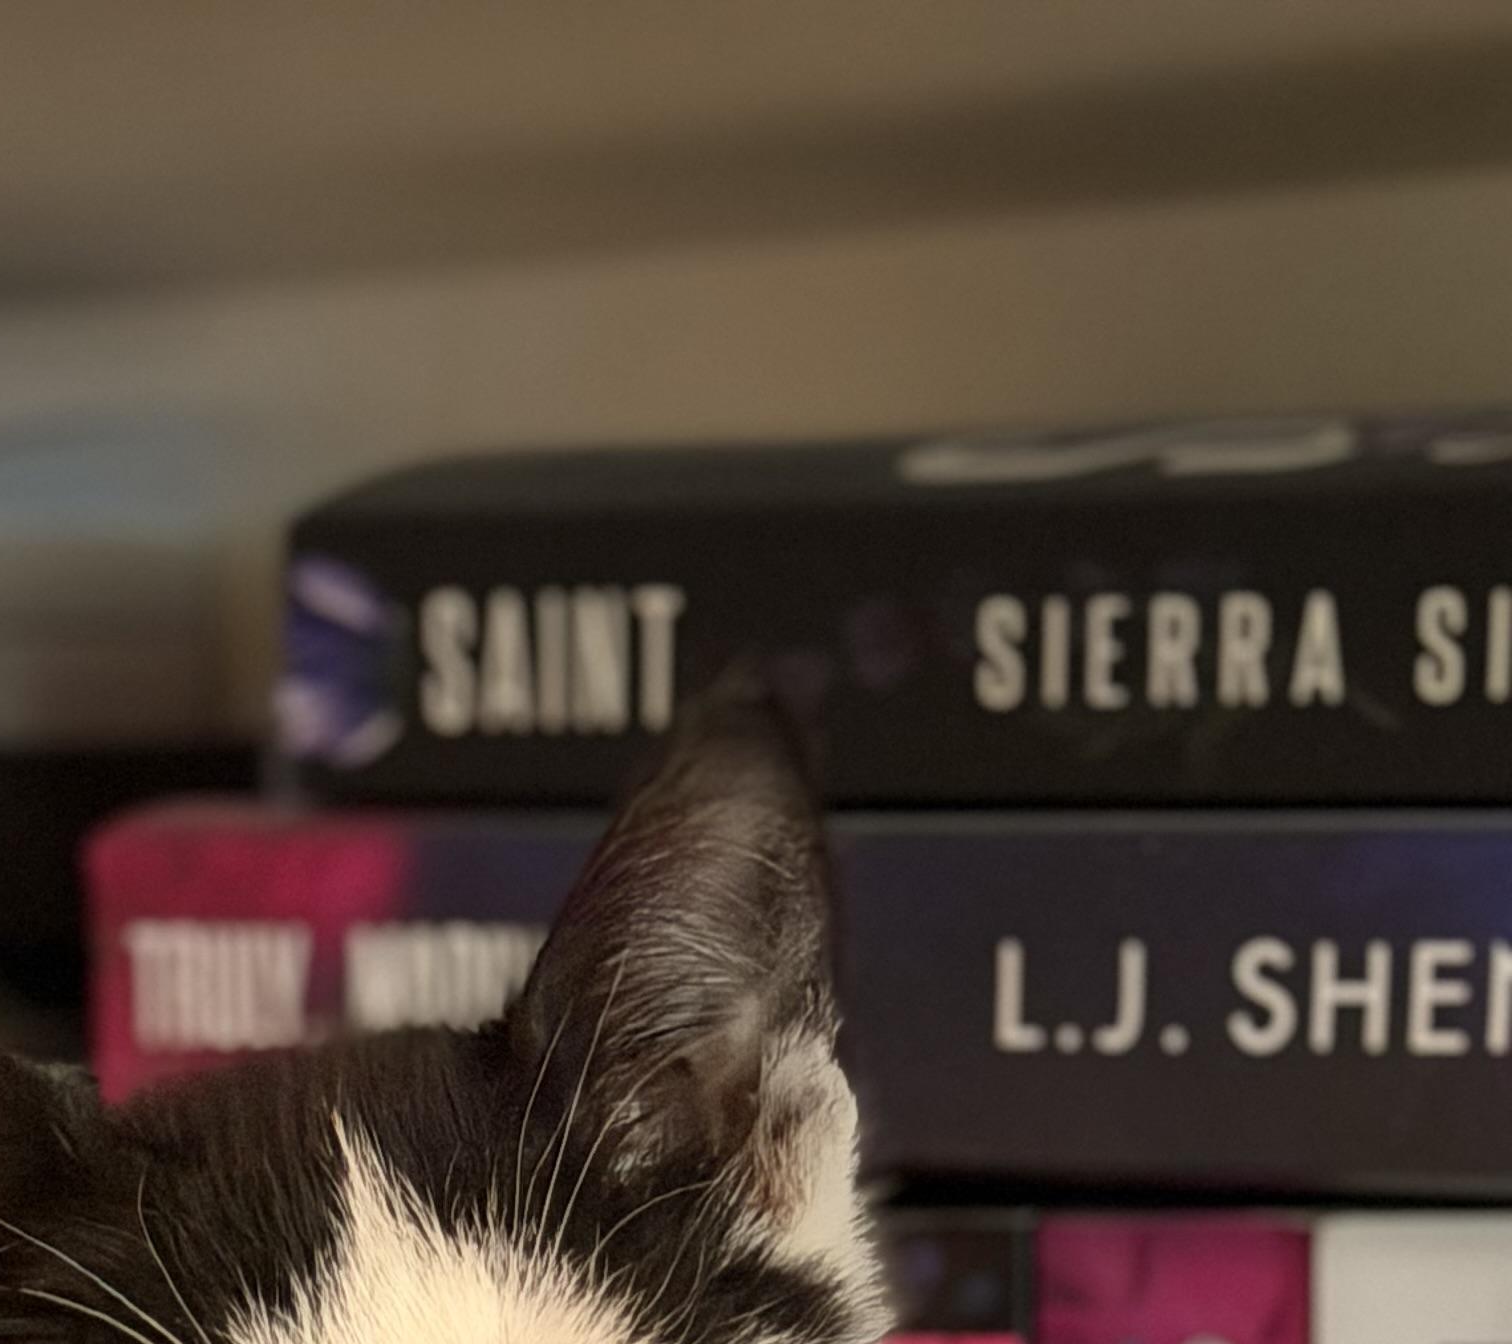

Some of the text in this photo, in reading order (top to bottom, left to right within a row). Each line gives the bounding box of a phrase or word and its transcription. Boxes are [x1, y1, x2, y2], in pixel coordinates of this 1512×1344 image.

[418, 582, 684, 735] SAINT
[974, 590, 1346, 710] SIERRA
[992, 936, 1190, 1056] L.J.
